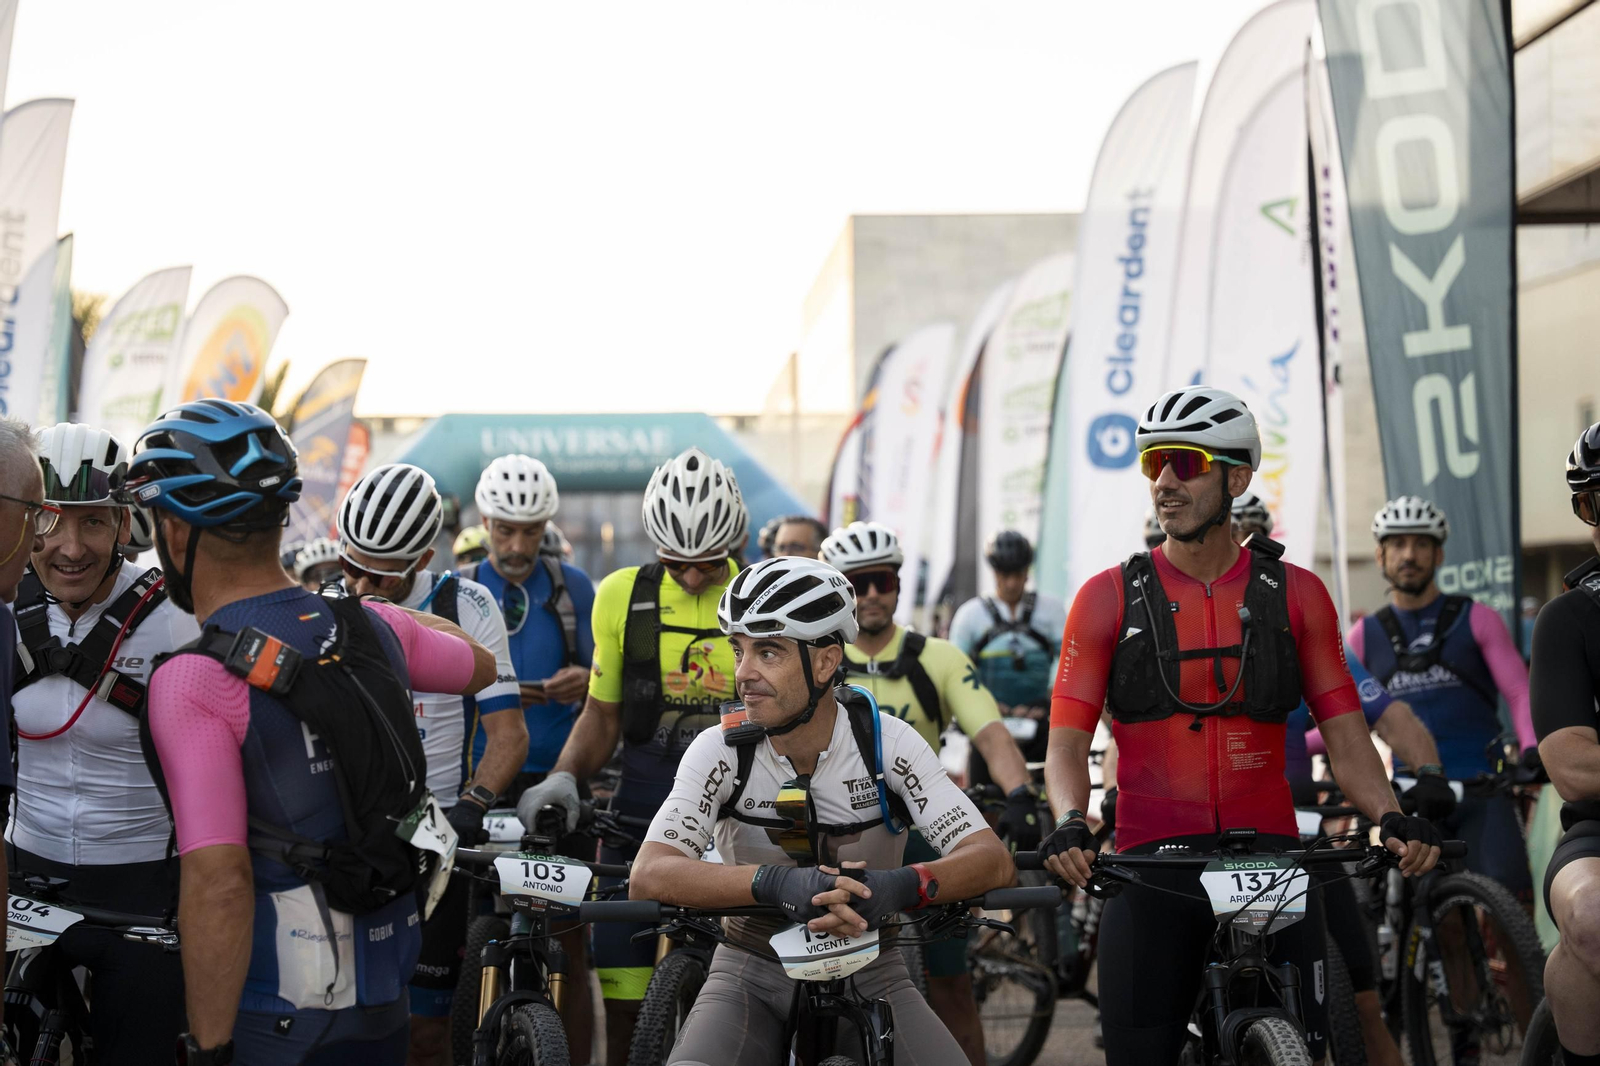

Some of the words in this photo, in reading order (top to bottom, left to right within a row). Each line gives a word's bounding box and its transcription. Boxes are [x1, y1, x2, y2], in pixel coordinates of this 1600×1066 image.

[1106, 186, 1154, 396] Cleardent
[1260, 573, 1278, 589] evoc
[842, 779, 876, 793] TITA
[850, 791, 879, 802] DESER
[757, 801, 778, 809] ATI
[929, 811, 952, 830] COSTA
[951, 805, 962, 813] DE
[941, 821, 972, 848] ATIKA
[520, 861, 566, 883] 103
[1224, 861, 1279, 870] SKODA
[522, 880, 563, 893] ANTONIO
[1231, 872, 1277, 892] 137
[1259, 894, 1287, 902] DAVID
[7, 896, 51, 918] 04
[7, 911, 32, 923] ORDI
[369, 922, 394, 942] GOBIK
[806, 937, 850, 954] VICENTE
